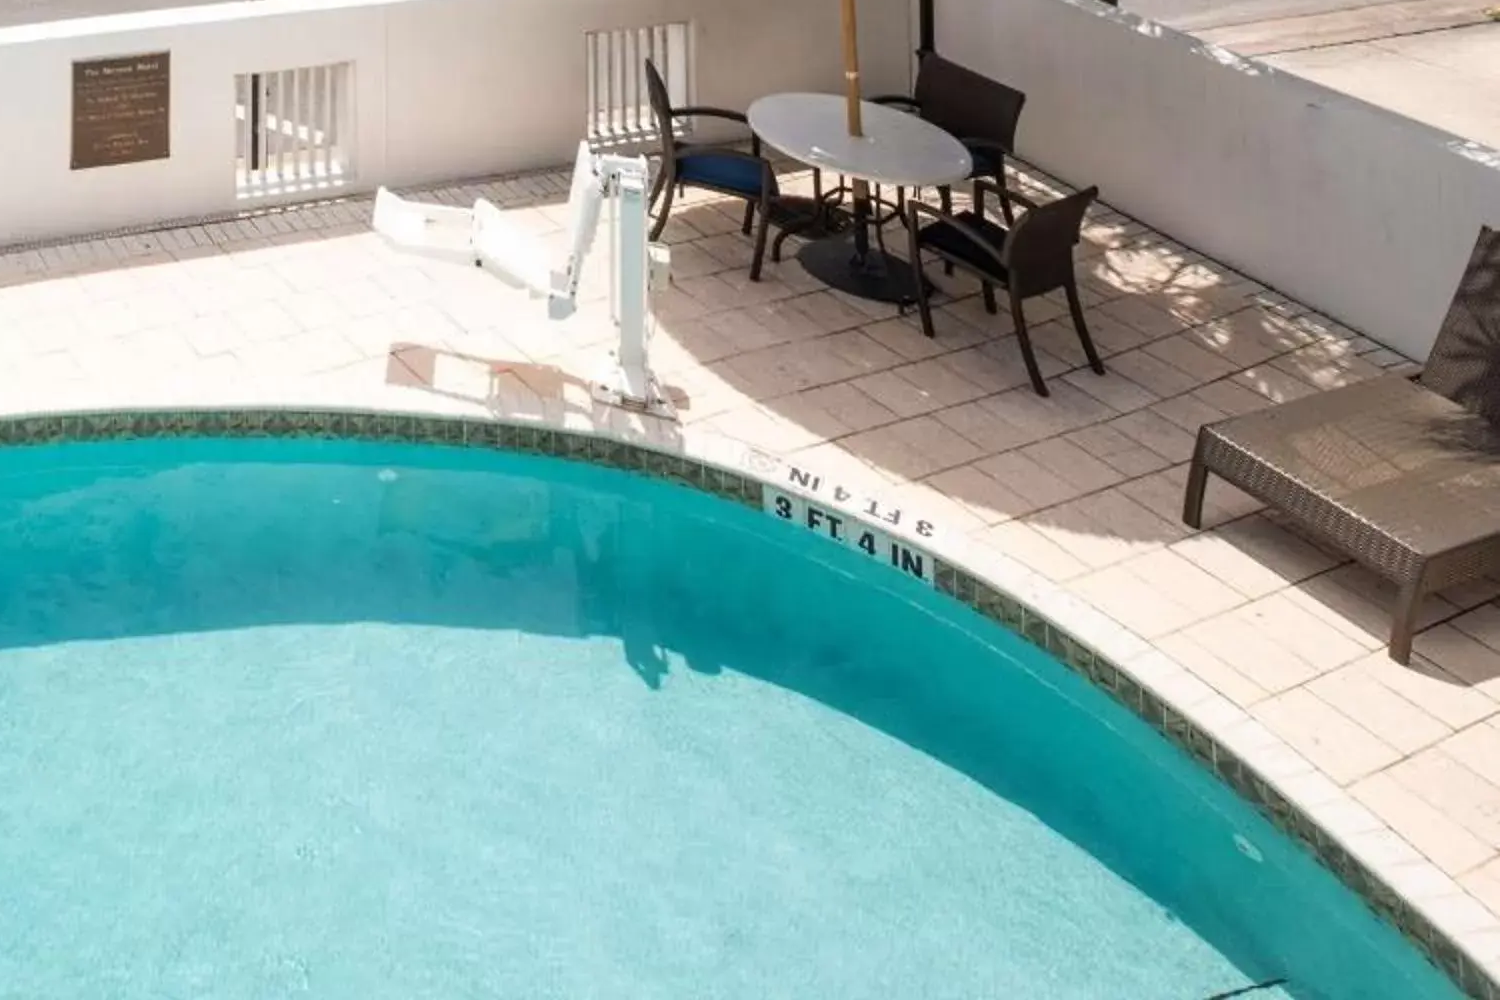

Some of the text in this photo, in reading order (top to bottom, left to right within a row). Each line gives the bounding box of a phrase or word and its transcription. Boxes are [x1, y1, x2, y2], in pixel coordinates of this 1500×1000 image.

[833, 486, 852, 501] 4
[775, 495, 793, 520] 3
[857, 531, 877, 556] 4
[915, 519, 935, 537] 3
